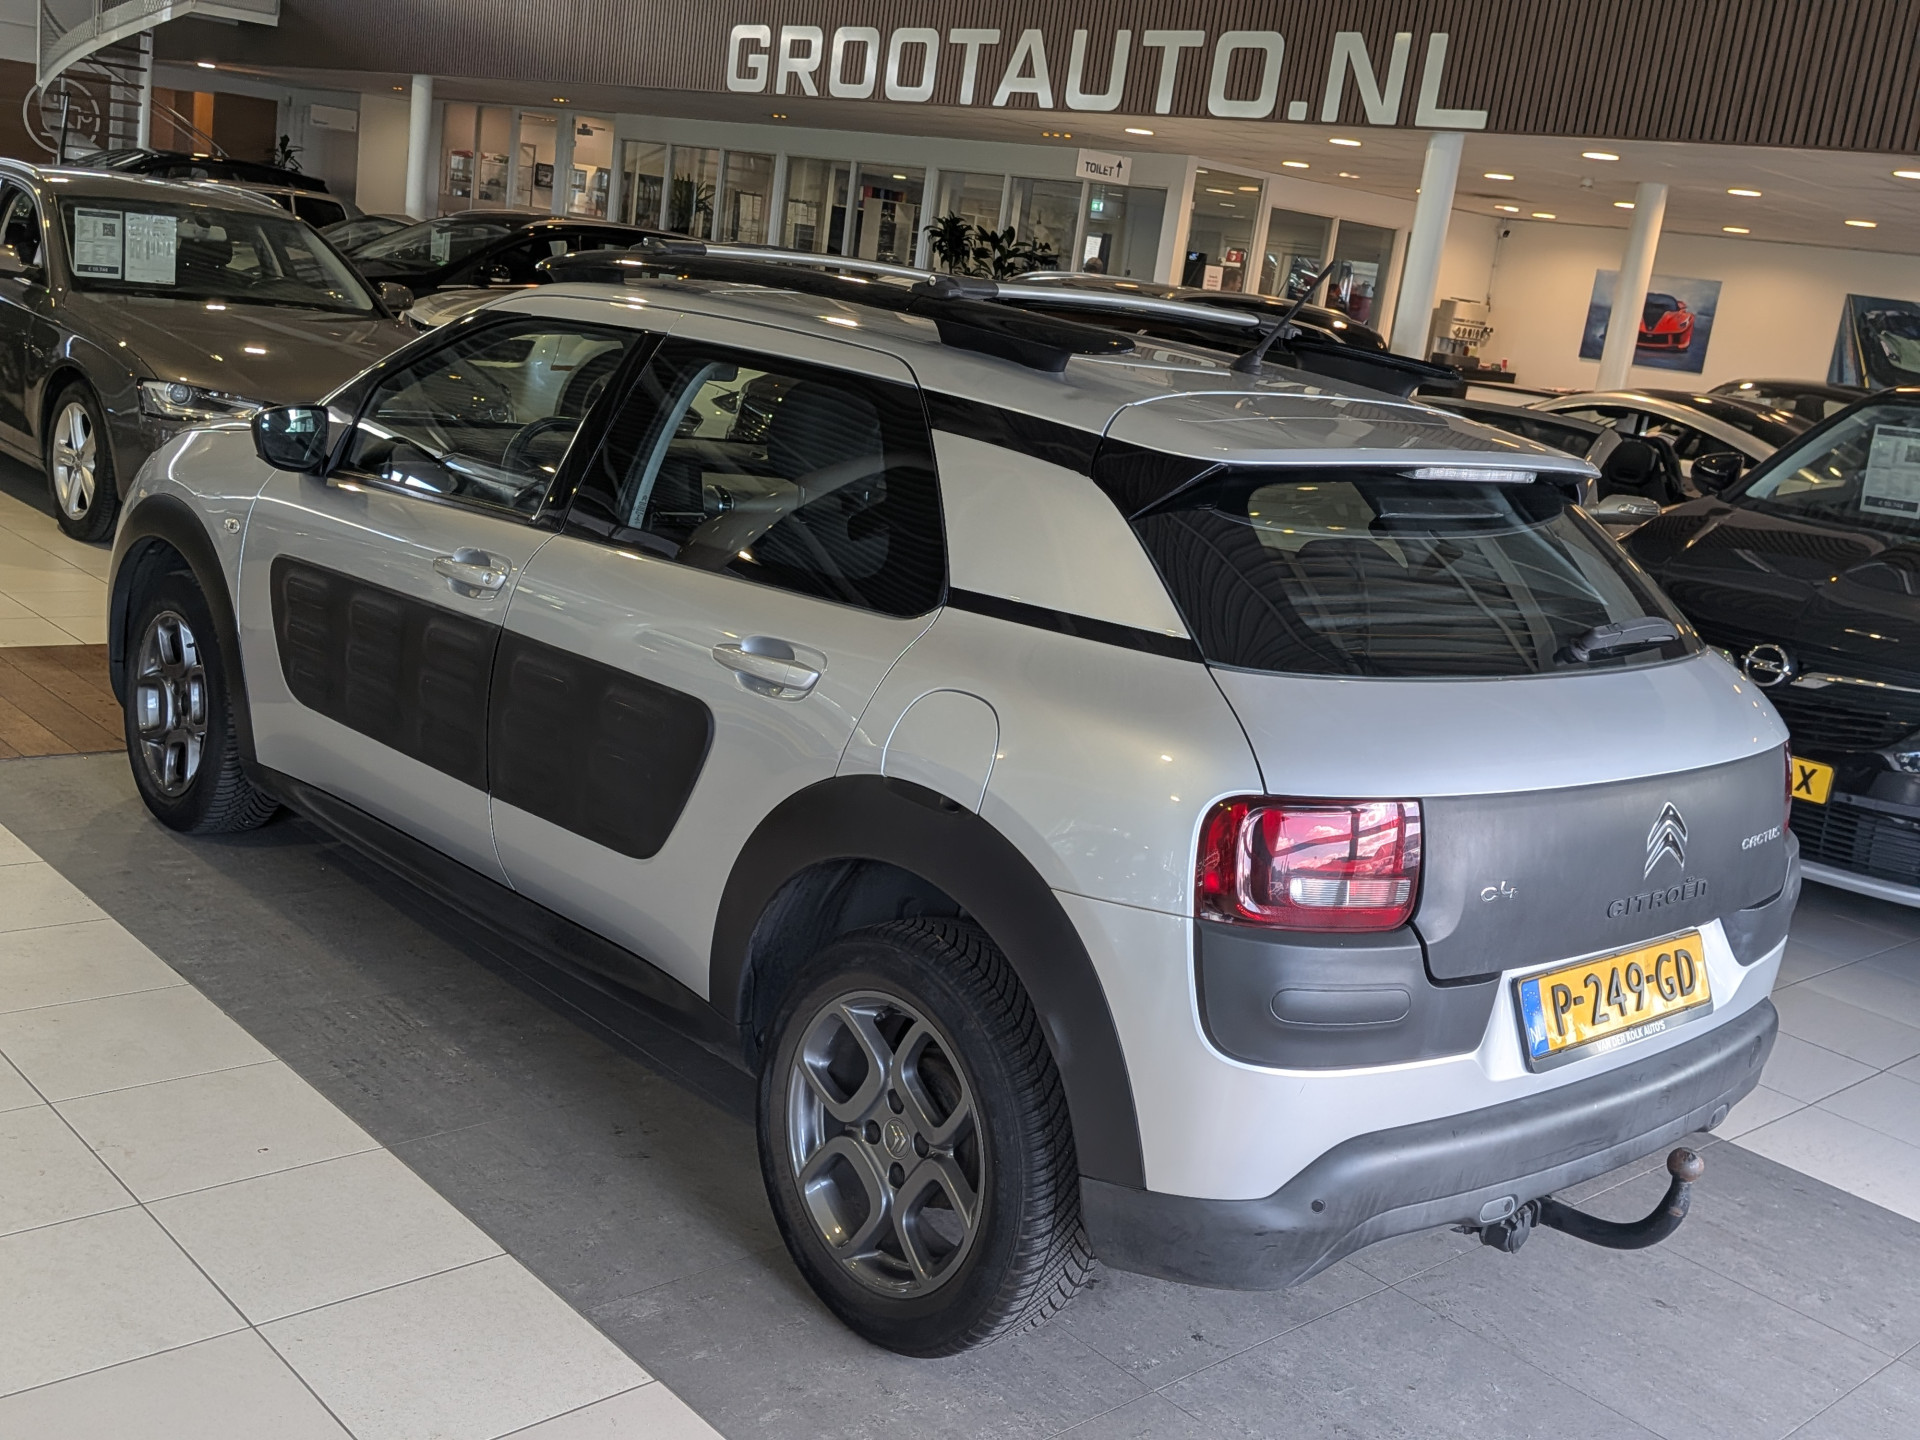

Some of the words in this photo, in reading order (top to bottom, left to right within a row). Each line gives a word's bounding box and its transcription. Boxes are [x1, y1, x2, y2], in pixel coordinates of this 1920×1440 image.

[727, 25, 1488, 129] GROOTAUTO.NL
[1085, 161, 1114, 177] TOILET
[1741, 825, 1780, 850] CACTUS
[1480, 880, 1518, 902] C4
[1551, 949, 1697, 1036] P-249-GD
[1530, 1025, 1546, 1050] NL
[1596, 1038, 1612, 1052] VAN
[1611, 1033, 1627, 1048] DER
[1625, 1027, 1644, 1043] KOLK
[1643, 1019, 1666, 1036] AUTO'S
